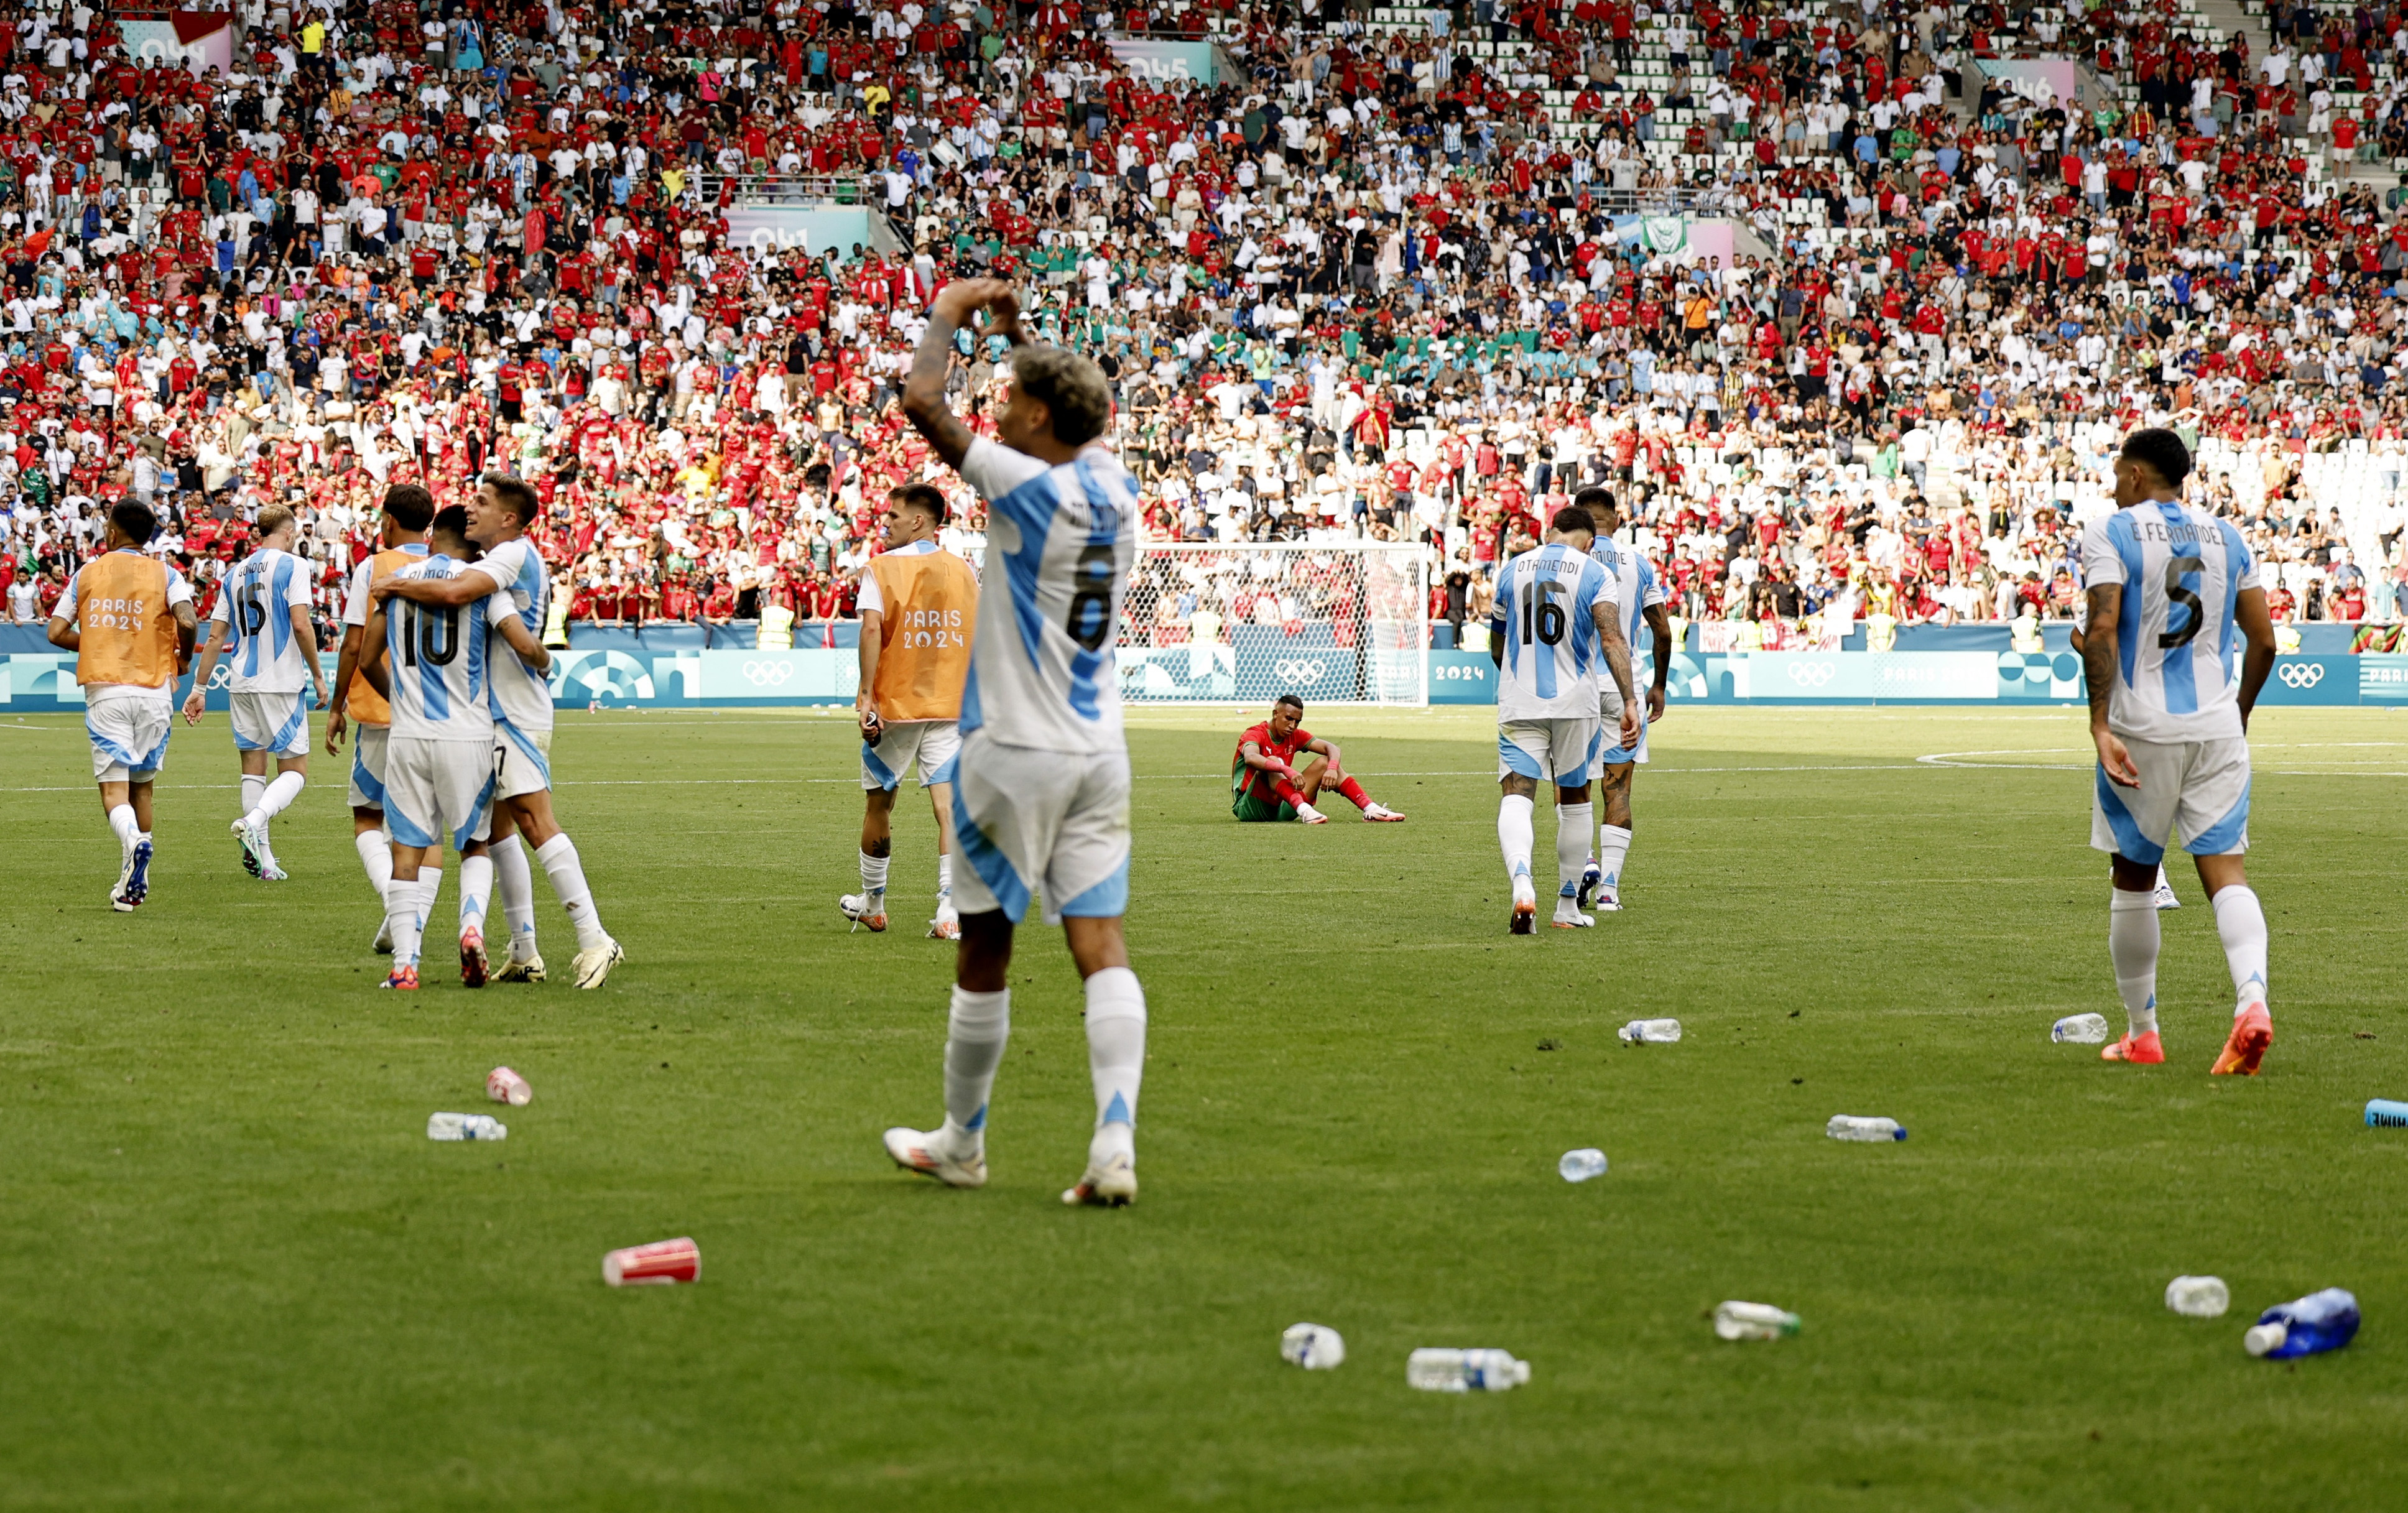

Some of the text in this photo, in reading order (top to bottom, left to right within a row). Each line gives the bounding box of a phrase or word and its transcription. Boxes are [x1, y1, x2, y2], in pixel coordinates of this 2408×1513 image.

[1518, 560, 1580, 575] OTAMENDI
[236, 581, 266, 637] 15
[1067, 545, 1117, 652] 8
[1522, 581, 1567, 645] 16
[2158, 556, 2206, 649] 5
[89, 614, 142, 631] 2024
[404, 597, 458, 667] 10
[904, 630, 964, 649] 2024
[1435, 665, 1484, 680] 2024
[494, 746, 506, 777] 7
